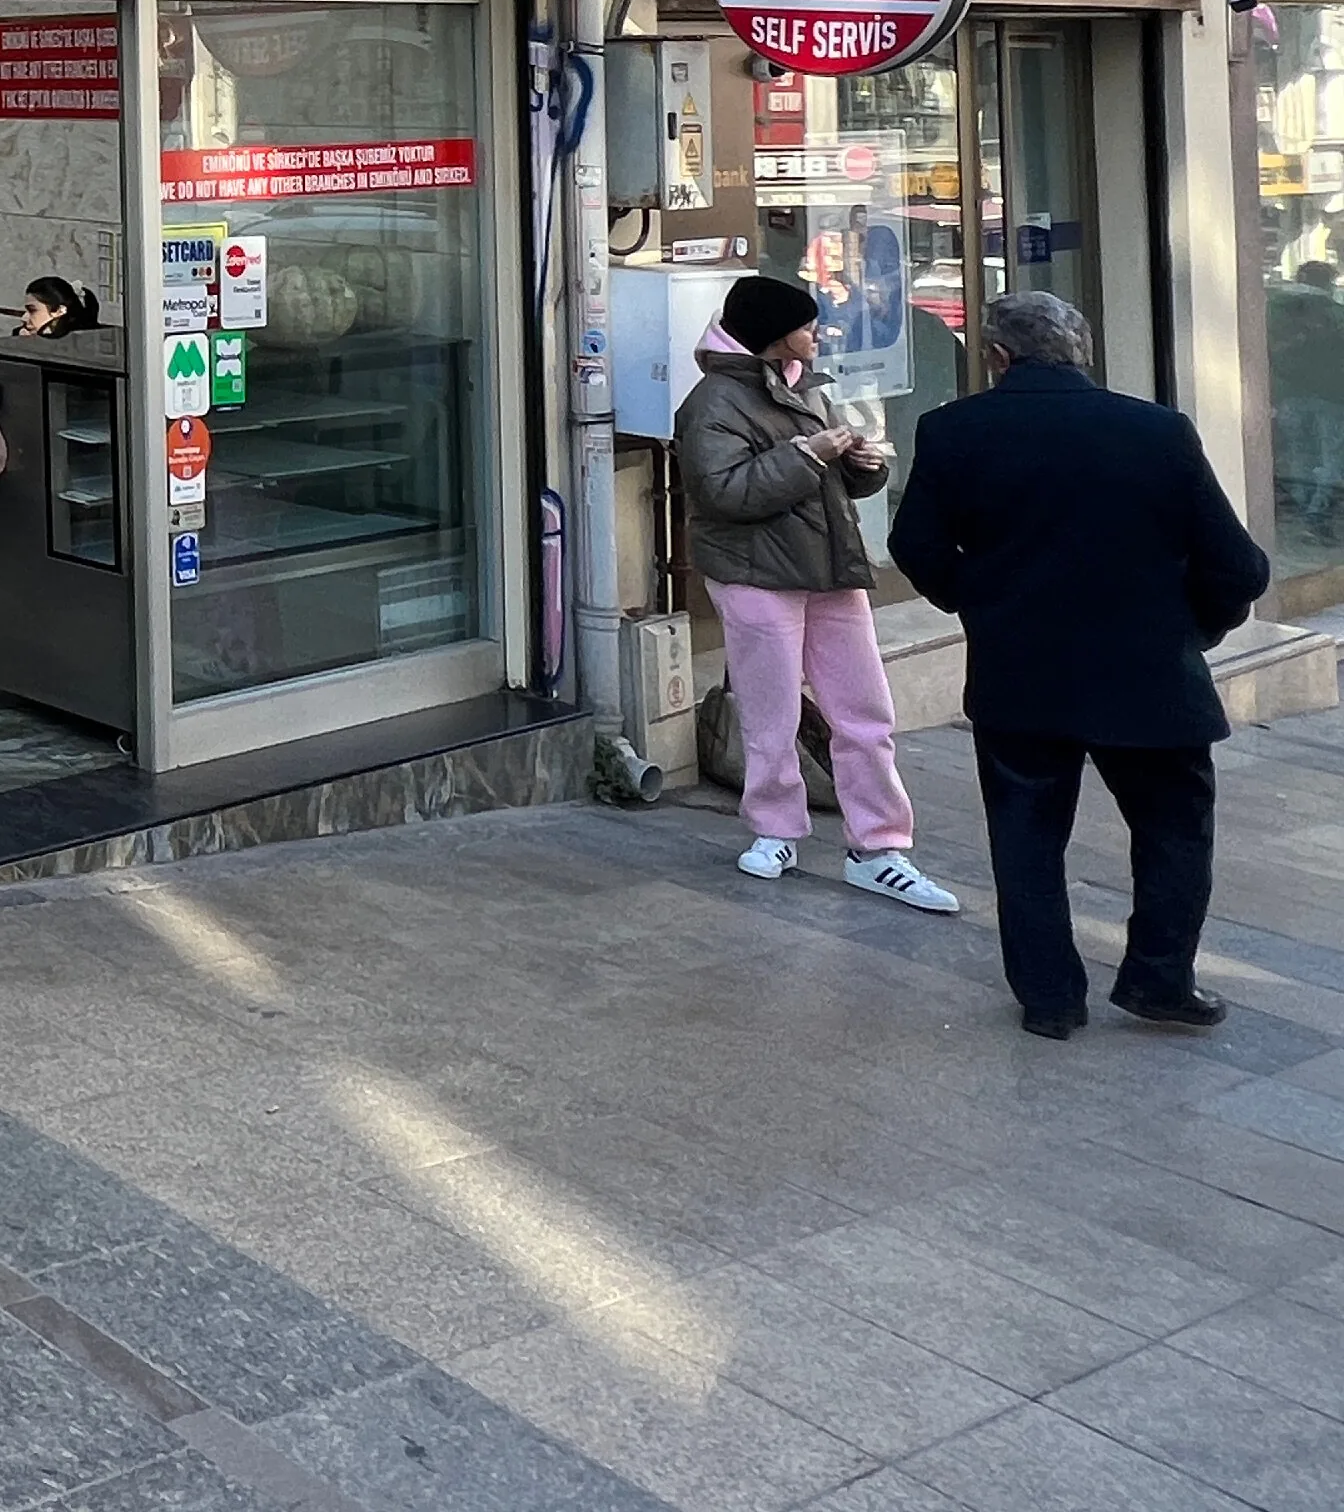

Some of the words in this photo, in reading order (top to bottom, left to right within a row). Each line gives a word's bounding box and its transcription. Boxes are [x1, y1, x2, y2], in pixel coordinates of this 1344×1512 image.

[751, 15, 808, 55] SELF
[812, 14, 898, 59] SERVİS
[247, 176, 269, 196] ANY
